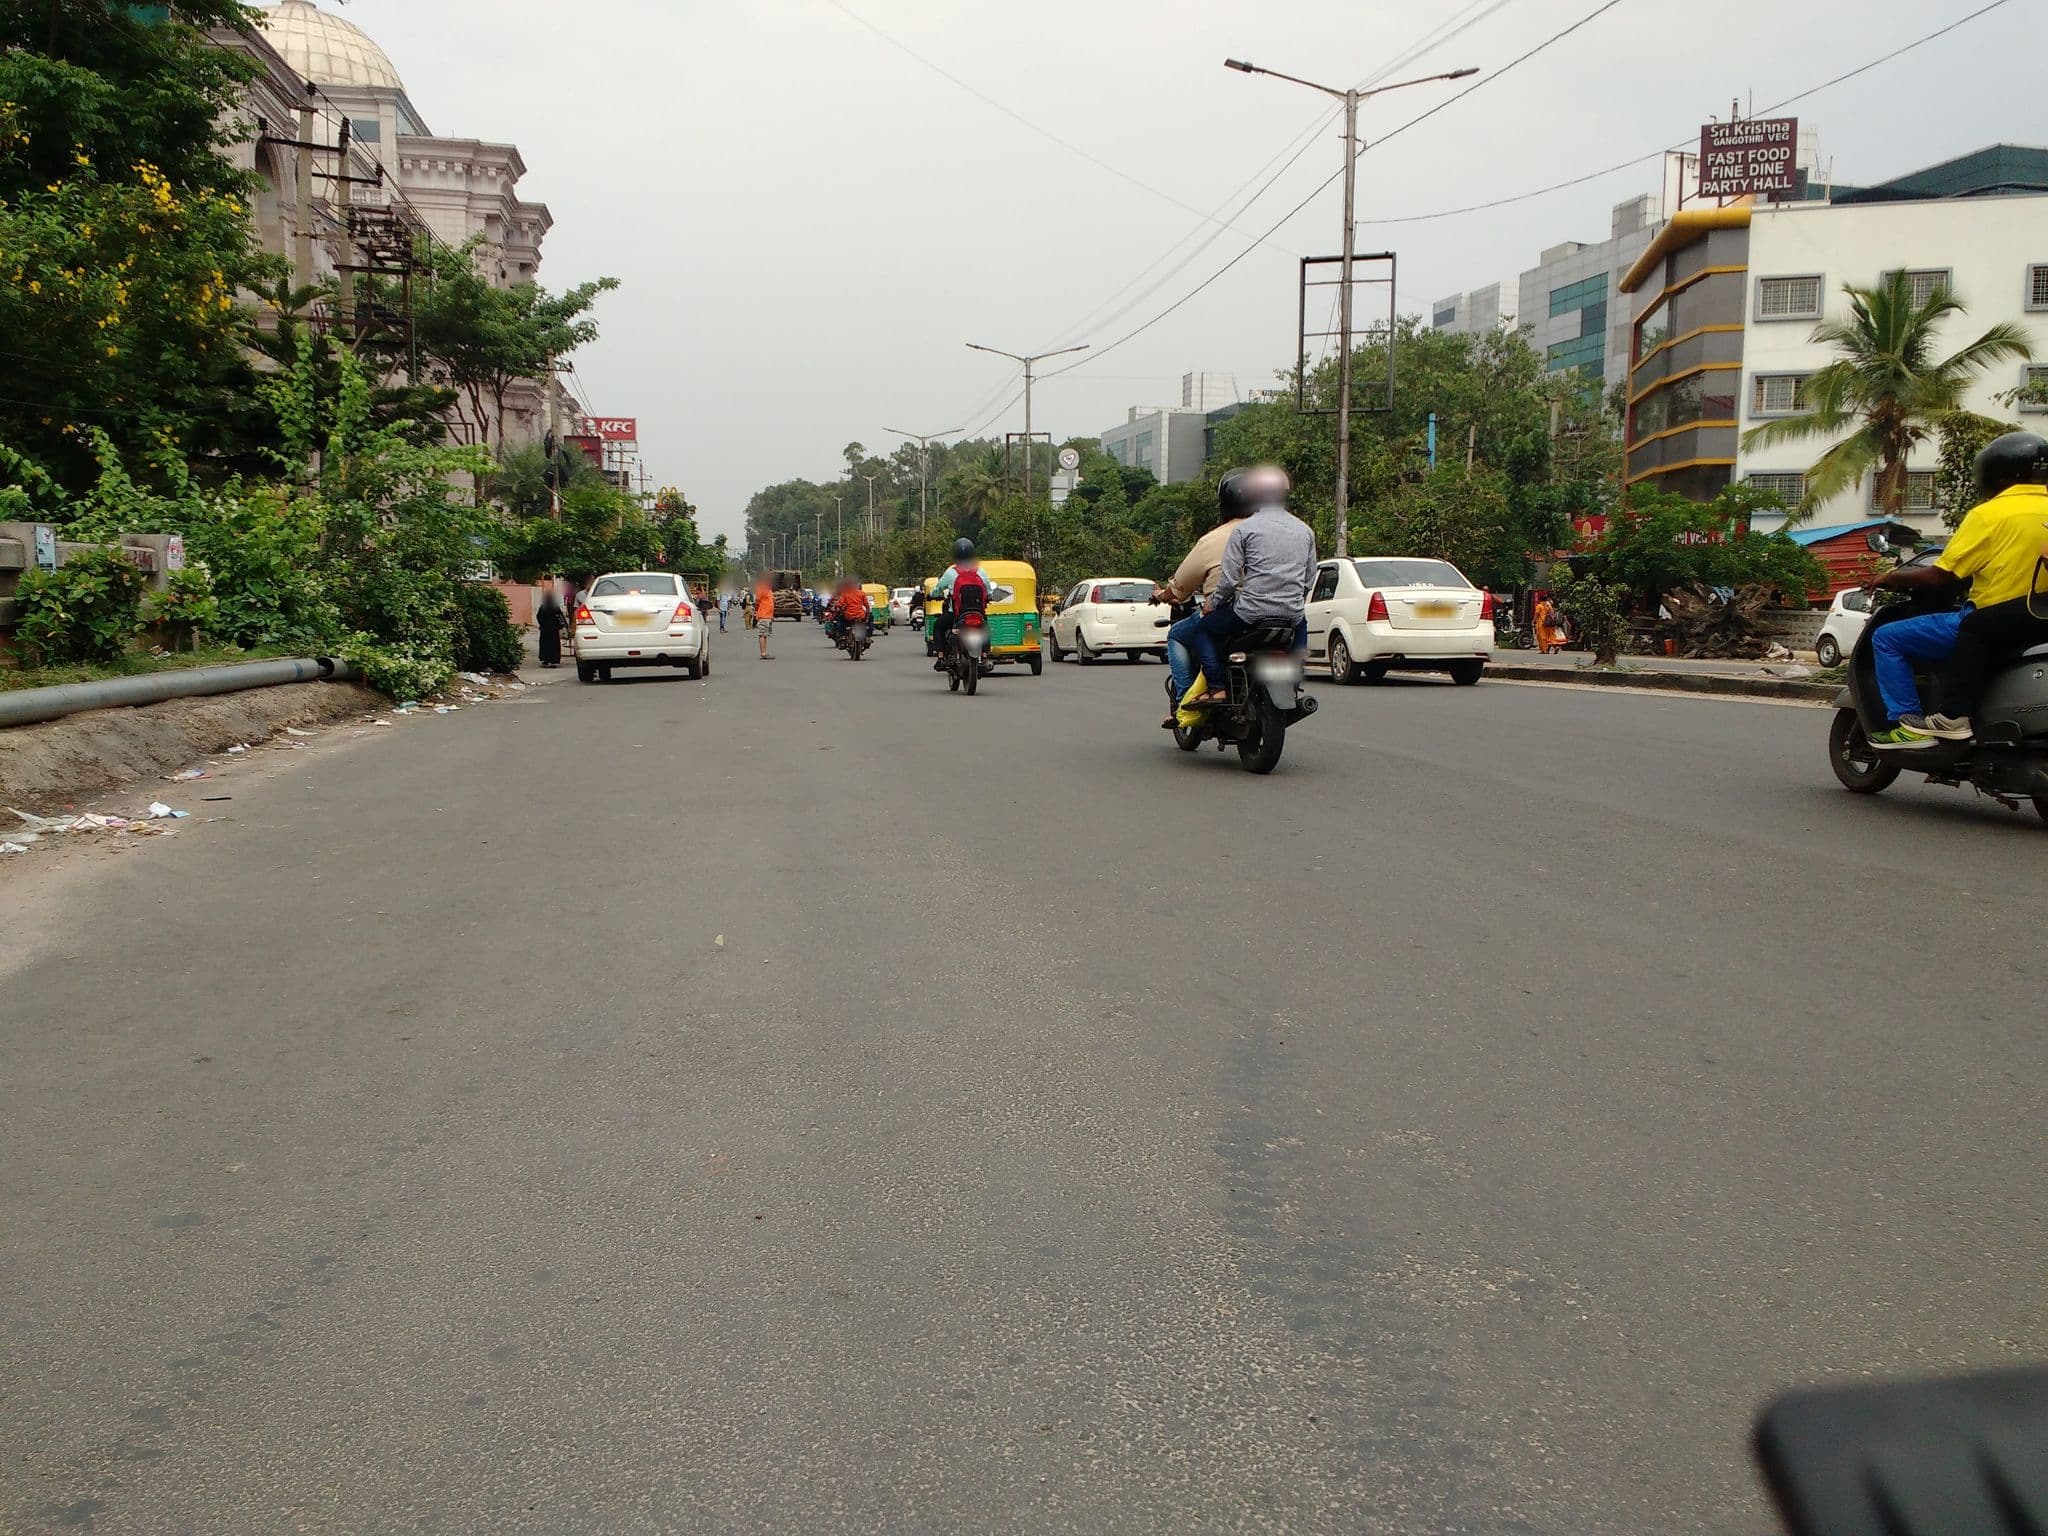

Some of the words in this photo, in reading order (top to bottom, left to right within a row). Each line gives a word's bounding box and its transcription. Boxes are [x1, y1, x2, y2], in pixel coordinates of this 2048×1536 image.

[1710, 125, 1729, 138] Sri
[1734, 121, 1790, 136] Krishna
[1713, 134, 1764, 146] GANGOTHRI
[1768, 132, 1790, 142] VEG
[1707, 151, 1745, 166] FAST
[1748, 147, 1790, 163] FOOD
[1711, 164, 1744, 179] FINE
[1749, 161, 1784, 176] DINE
[1702, 178, 1750, 195] PARTY
[1753, 176, 1792, 190] HALL
[601, 420, 633, 433] KFC
